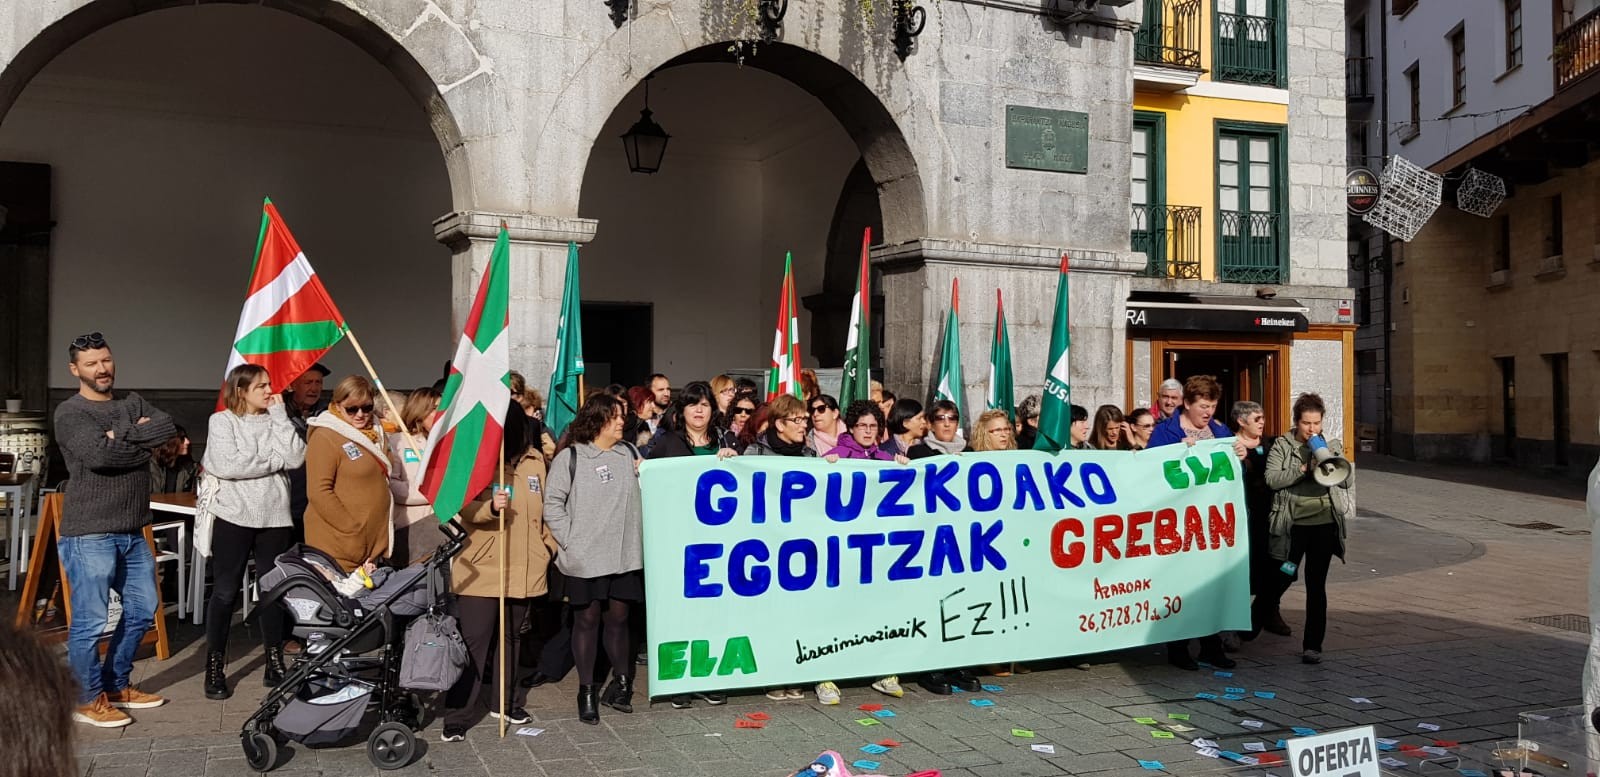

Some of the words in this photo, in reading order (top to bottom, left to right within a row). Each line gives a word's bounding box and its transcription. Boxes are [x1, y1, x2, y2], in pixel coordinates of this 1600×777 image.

[1125, 309, 1146, 325] RA
[1261, 317, 1295, 327] Heineken
[1163, 451, 1235, 490] ELA
[694, 461, 1117, 526] GIPUZKOAKO
[683, 519, 1007, 598] EGOITZAK
[1050, 502, 1236, 568] GREBAN
[657, 635, 758, 681] ELA
[1298, 736, 1373, 777] OFERTA
